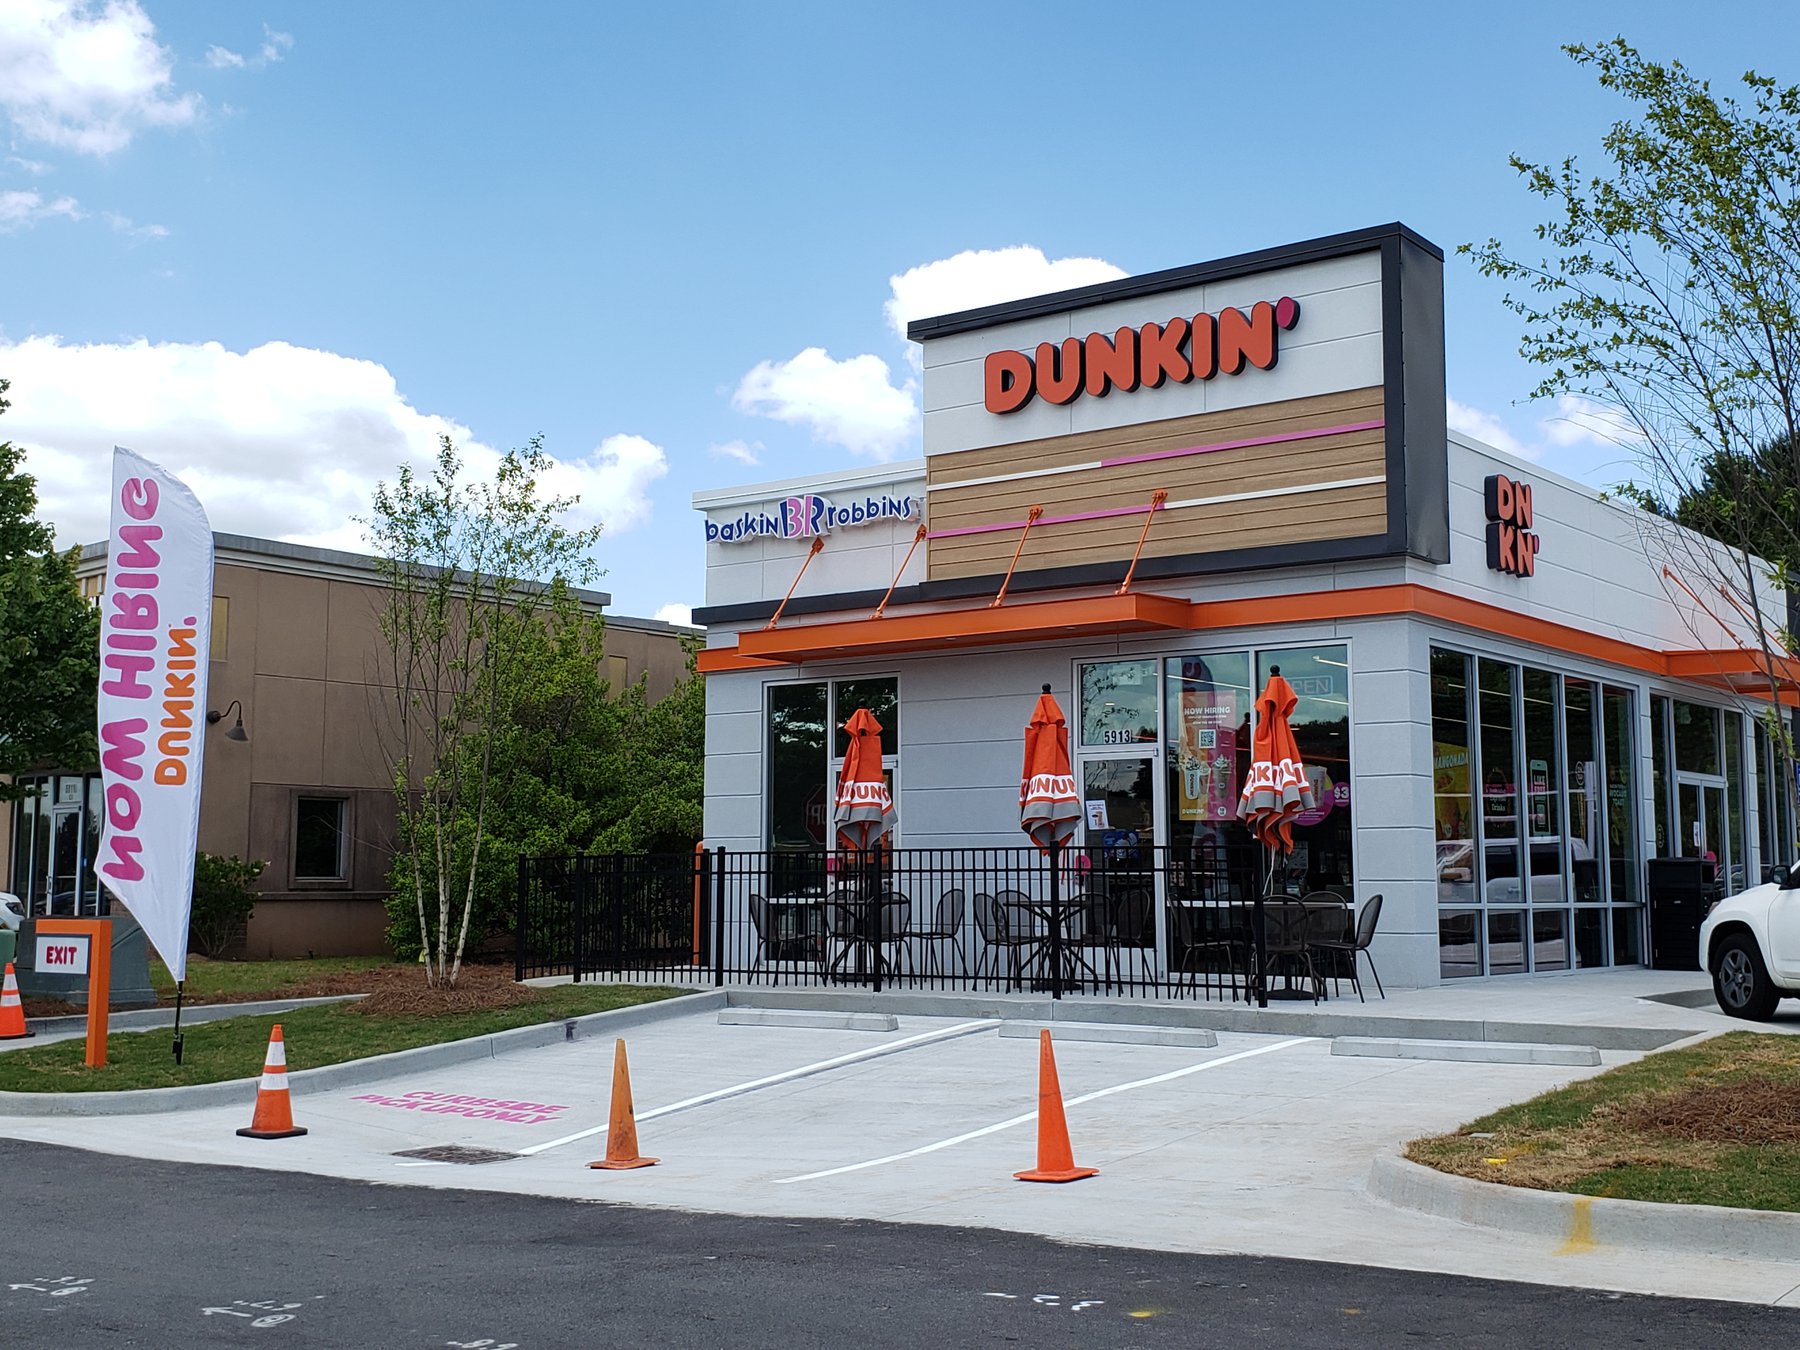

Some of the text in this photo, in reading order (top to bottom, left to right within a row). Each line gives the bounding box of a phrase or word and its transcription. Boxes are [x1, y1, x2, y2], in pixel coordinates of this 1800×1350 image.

[984, 296, 1300, 414] DUNKIN'
[1493, 473, 1533, 529] DN
[704, 512, 779, 542] baskin
[827, 496, 912, 527] robbins
[1291, 678, 1329, 694] PEN
[1184, 705, 1231, 716] NOW HIRING
[1104, 729, 1131, 744] 5913
[46, 945, 78, 966] EXIT
[349, 1094, 428, 1110] PICK
[403, 1091, 571, 1114] CURBSIDE
